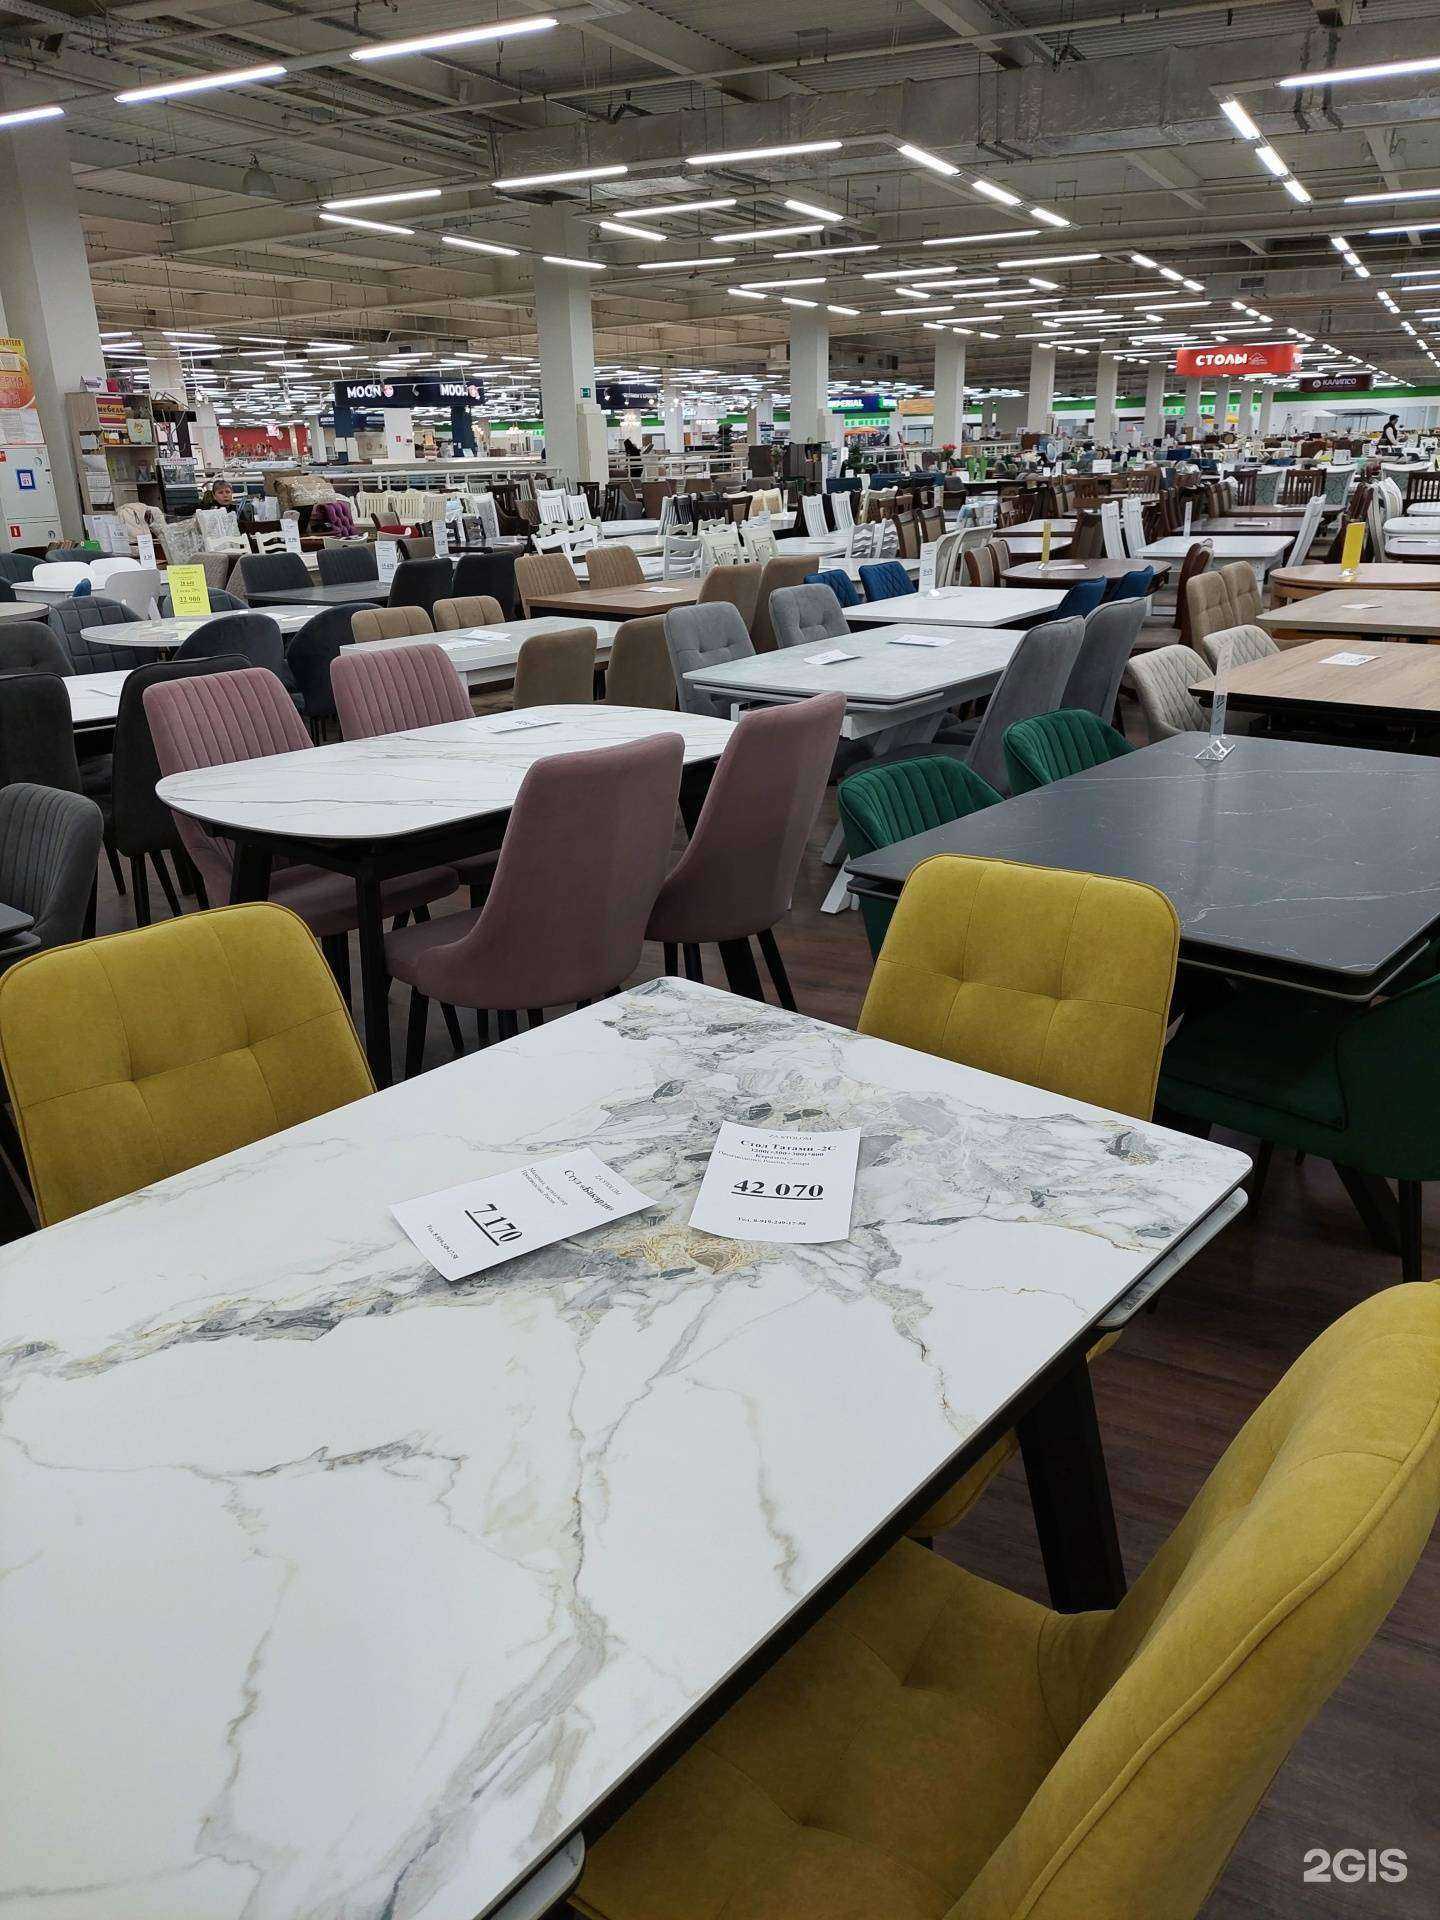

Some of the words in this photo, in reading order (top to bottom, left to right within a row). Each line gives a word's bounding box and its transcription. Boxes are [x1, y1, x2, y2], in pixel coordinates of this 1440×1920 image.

[1196, 352, 1248, 367] СТОЛЫ
[1322, 377, 1357, 386] КАЛИПСО
[346, 385, 382, 399] MOON
[740, 1140, 768, 1148] Стол
[734, 1179, 766, 1194] 42
[775, 1183, 824, 1197] 070
[483, 1216, 523, 1242] 170
